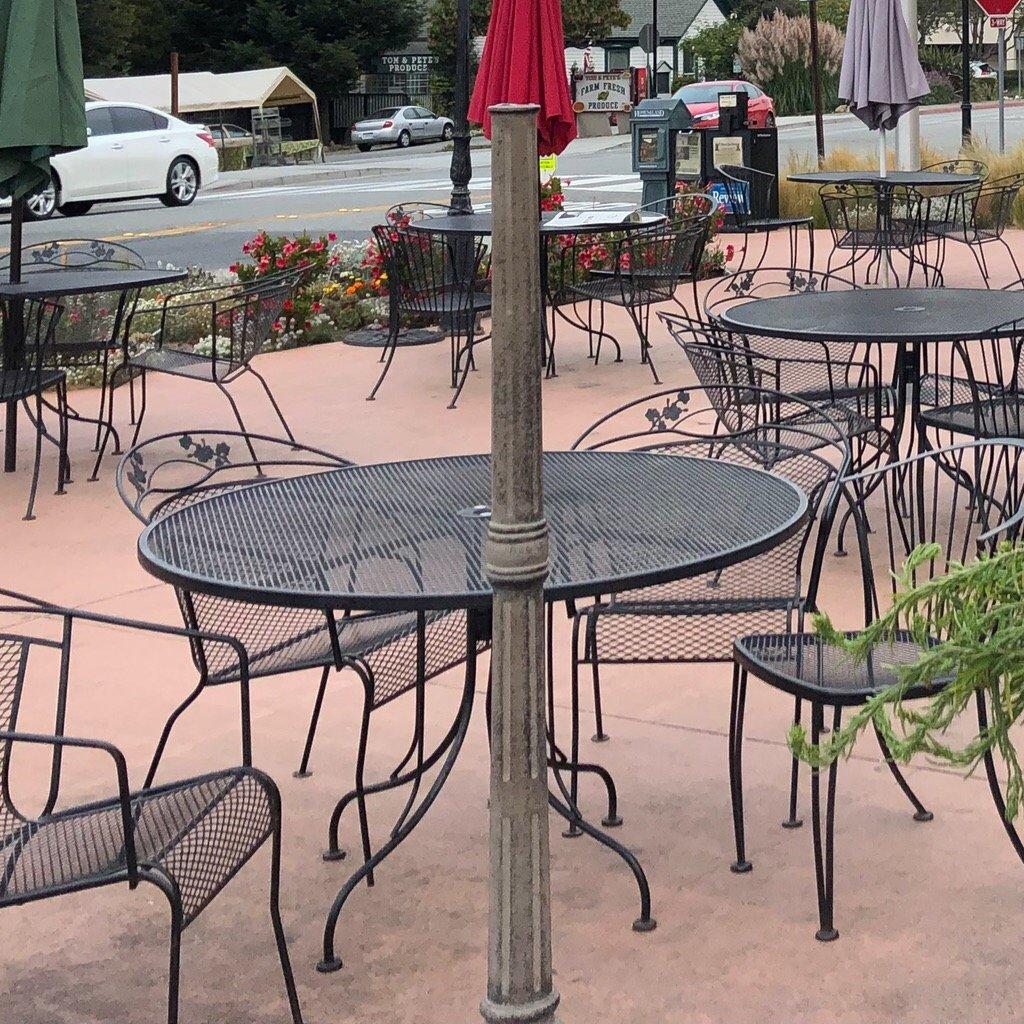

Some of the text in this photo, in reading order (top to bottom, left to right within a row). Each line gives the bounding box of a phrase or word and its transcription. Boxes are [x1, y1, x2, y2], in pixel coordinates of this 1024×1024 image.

[382, 56, 400, 65] TOM
[401, 56, 409, 64] &
[389, 64, 428, 72] PRODUCE
[580, 83, 600, 96] FARM
[603, 82, 626, 96] FRESH
[588, 101, 619, 110] PRODUCE
